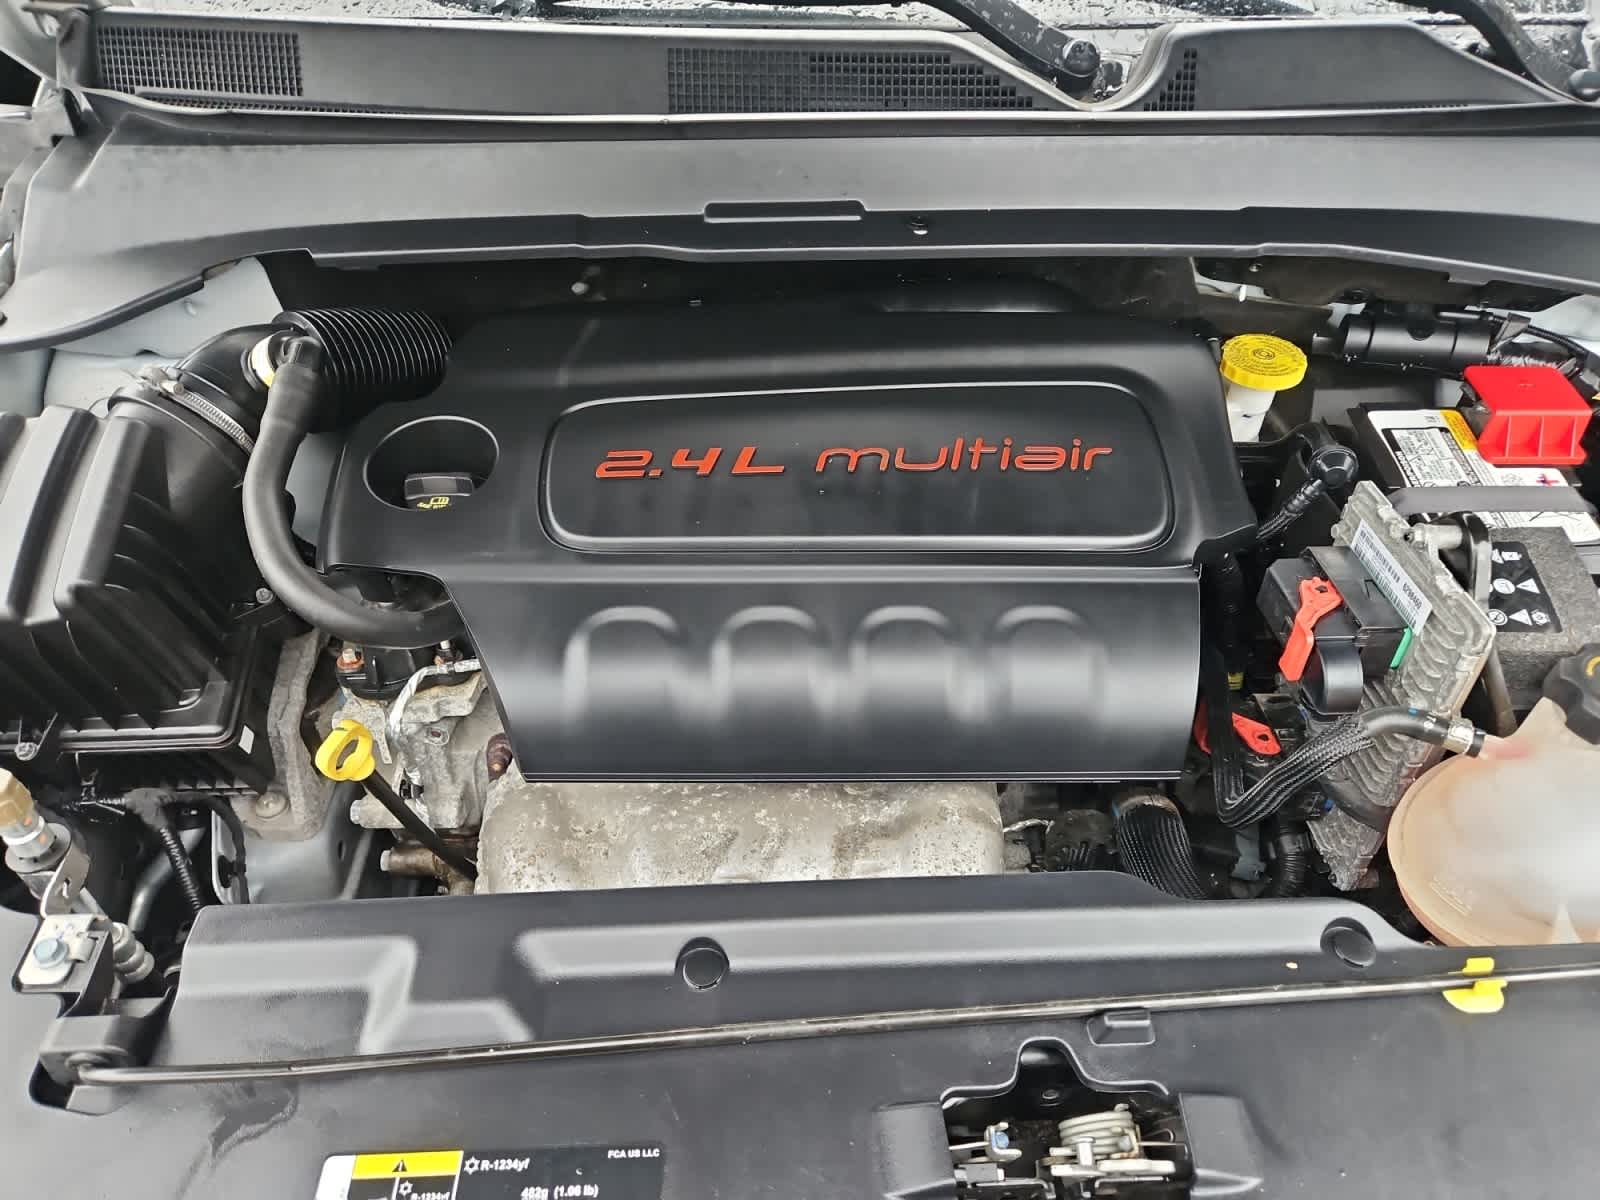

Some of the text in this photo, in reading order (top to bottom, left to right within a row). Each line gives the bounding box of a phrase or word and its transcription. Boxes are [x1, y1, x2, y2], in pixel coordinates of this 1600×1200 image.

[814, 437, 1113, 473] multiair
[607, 1148, 660, 1159] FCA US LLC
[480, 1157, 530, 1172] R-1234yf
[583, 1184, 599, 1198] lb)
